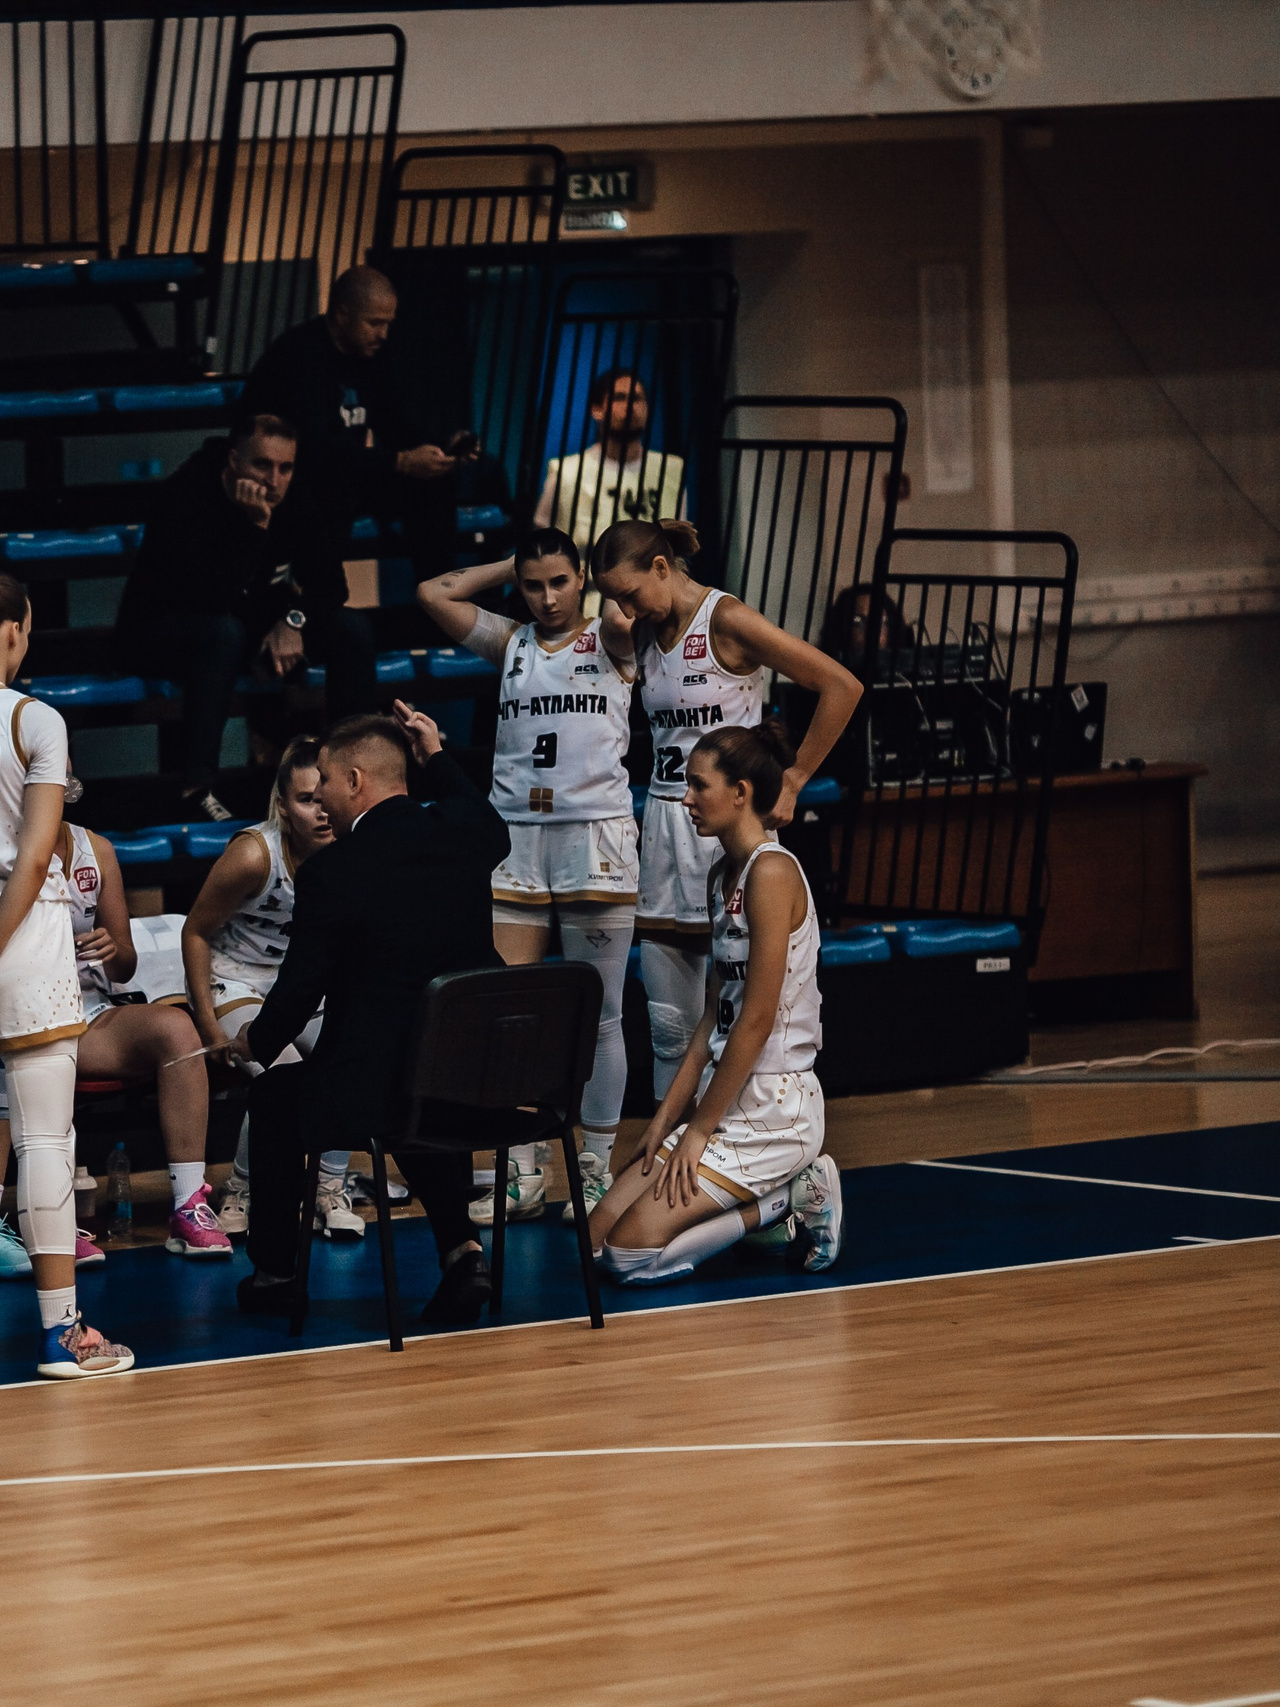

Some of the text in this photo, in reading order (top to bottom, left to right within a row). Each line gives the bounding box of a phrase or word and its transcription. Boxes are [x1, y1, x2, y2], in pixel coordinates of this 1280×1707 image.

[567, 171, 630, 201] EXIT
[685, 636, 705, 647] FON
[684, 645, 705, 657] BET
[532, 731, 558, 769] 9
[656, 745, 685, 782] 12
[76, 868, 96, 881] FON
[79, 877, 97, 890] BET
[706, 1146, 727, 1163] ПРОМ
